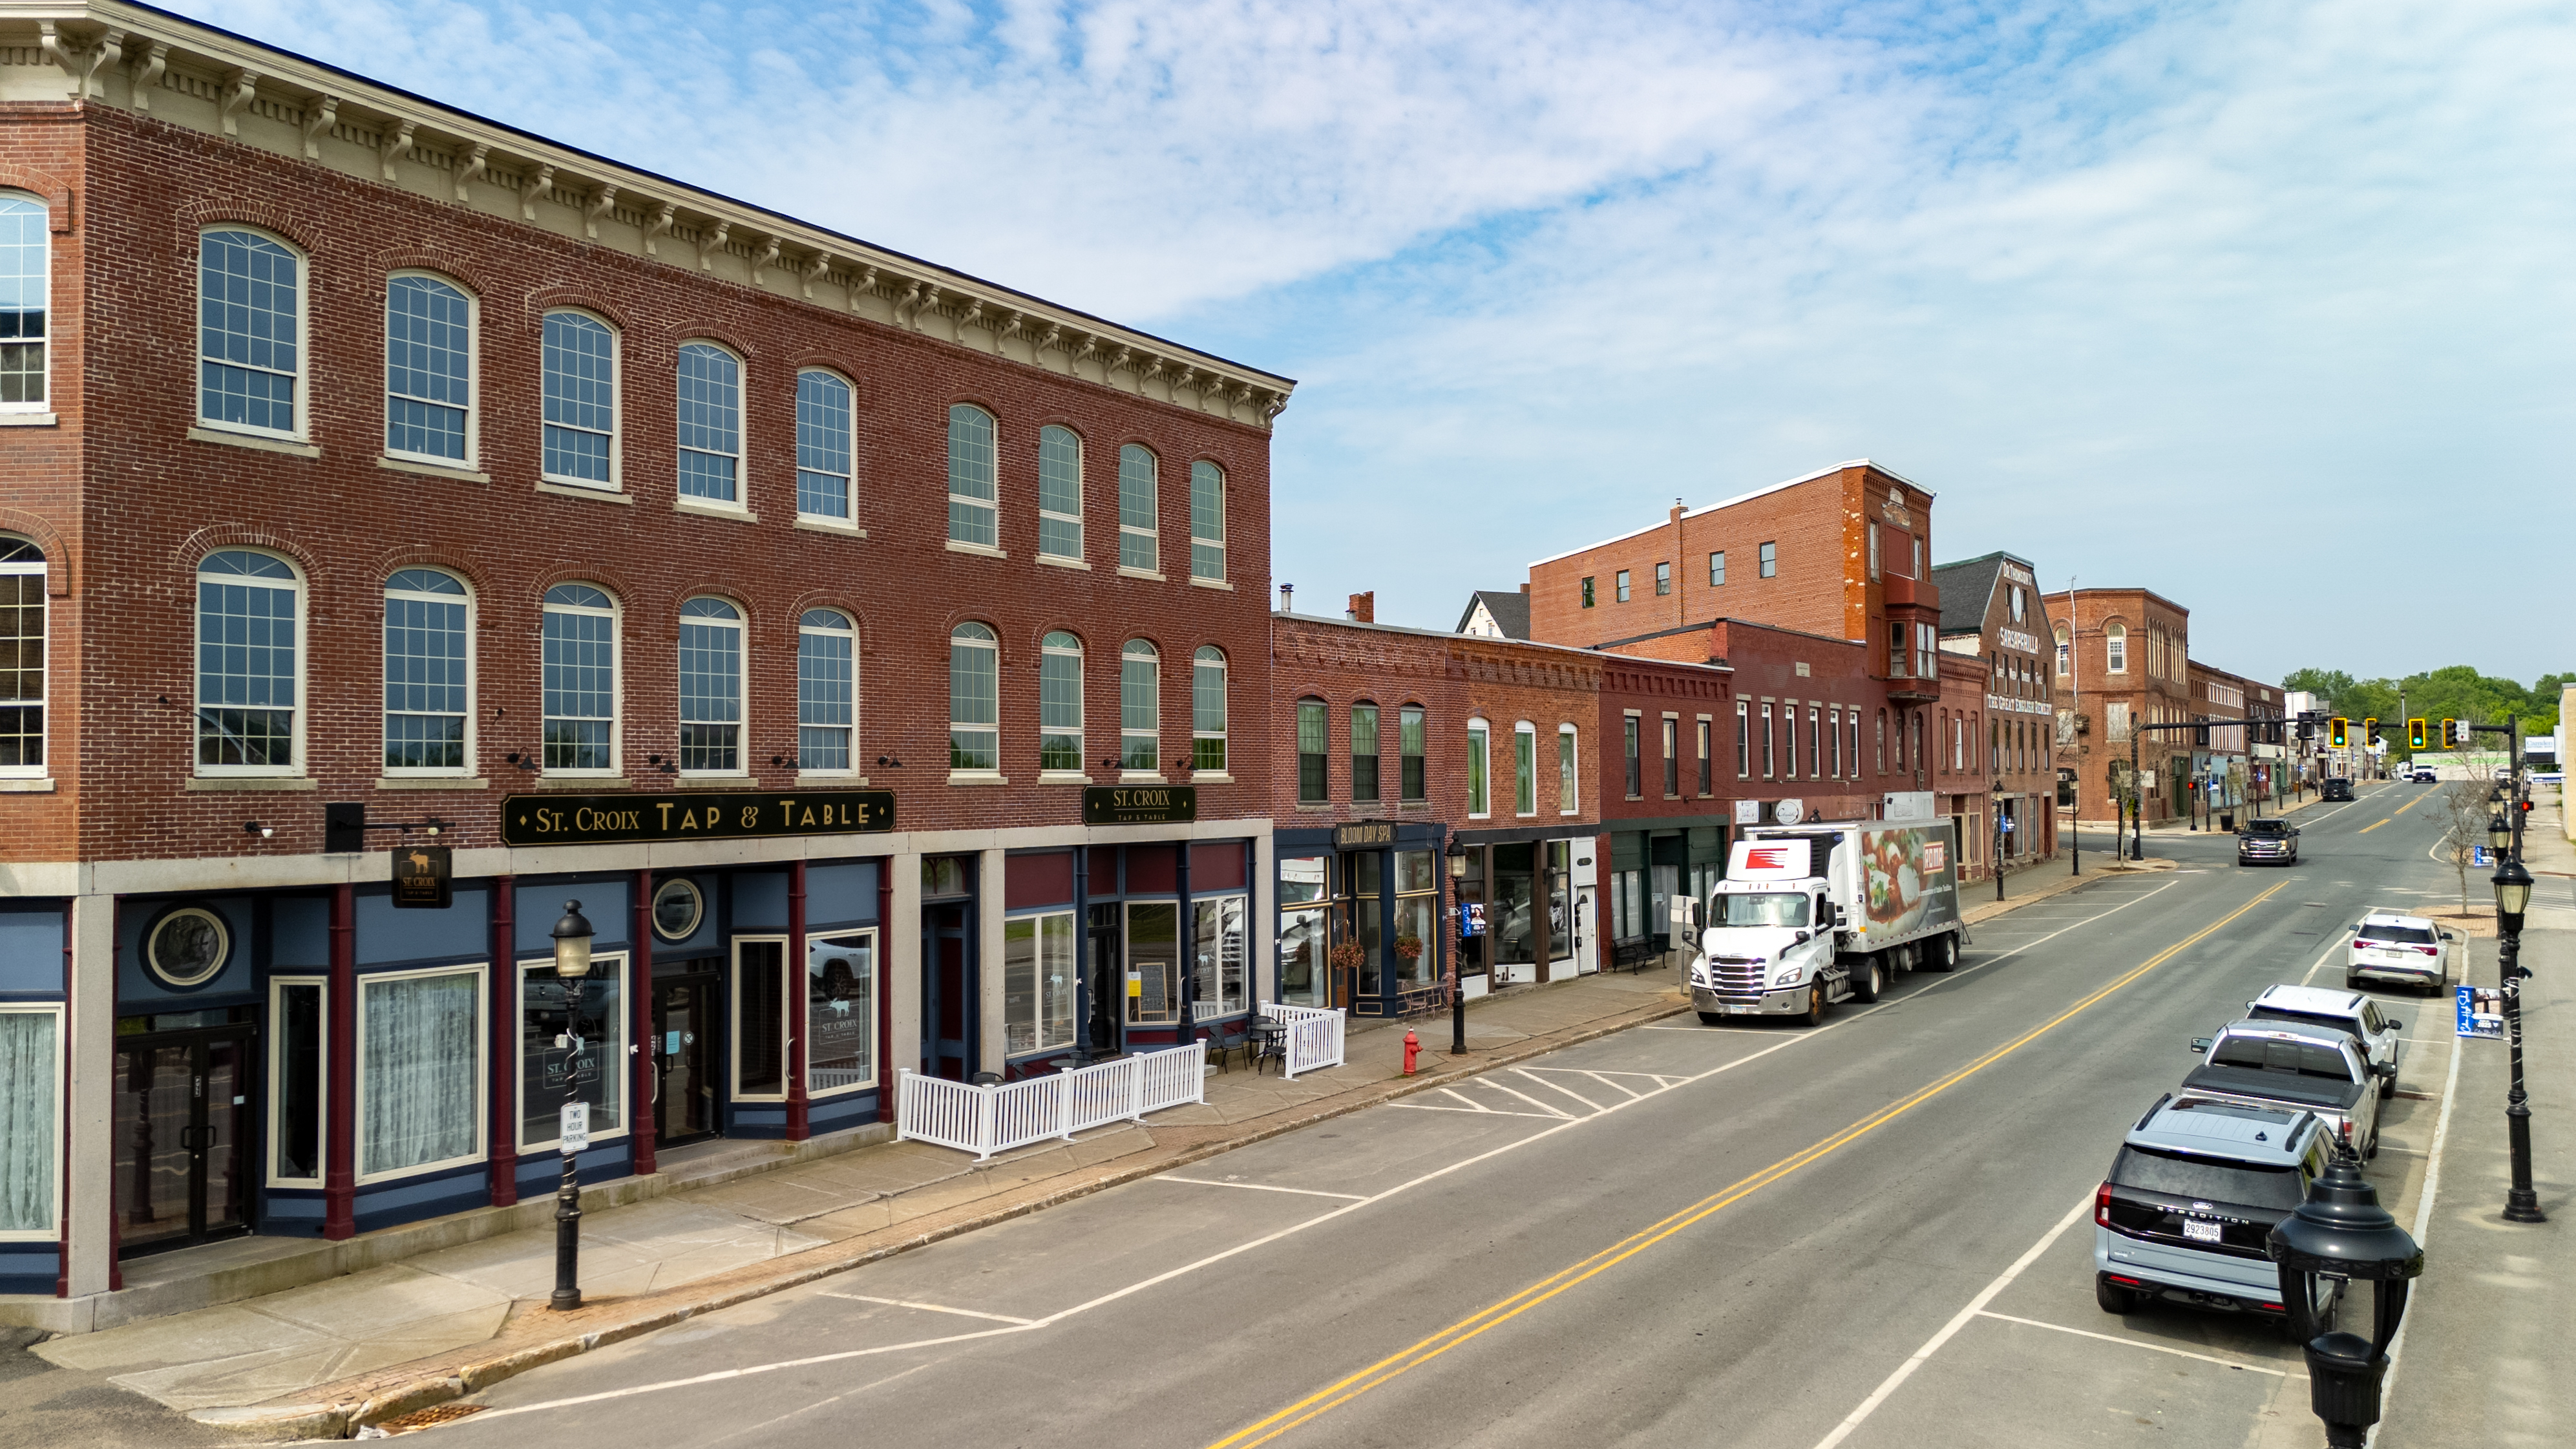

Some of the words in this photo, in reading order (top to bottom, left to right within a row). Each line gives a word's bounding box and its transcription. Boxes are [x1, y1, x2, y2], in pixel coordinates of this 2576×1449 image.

[2000, 626, 2038, 654] SARSAPARILLA
[1987, 693, 1998, 709] THE
[1999, 695, 2014, 712] GREAT
[1114, 790, 1131, 807] ST.
[1134, 790, 1170, 806] CROIX
[536, 808, 568, 832] ST.
[576, 807, 640, 831] CROIX
[656, 803, 720, 830] TAP
[741, 806, 758, 828] &
[779, 801, 870, 827] TABLE
[1341, 827, 1362, 844] BLOOM
[1364, 825, 1377, 843] DAY
[1378, 825, 1390, 842] SPA
[1925, 847, 1943, 869] ROMA
[403, 877, 412, 887] ST.
[414, 876, 435, 887] CROIX
[834, 1019, 857, 1030] CROIX
[547, 1063, 562, 1074] ST.
[564, 1057, 595, 1072] COIX
[569, 1110, 581, 1119] TWO
[567, 1121, 583, 1131] HOUR
[562, 1132, 586, 1144] PARKING
[2157, 1205, 2249, 1225] EXPEDITION
[2186, 1223, 2219, 1237] 2923805
